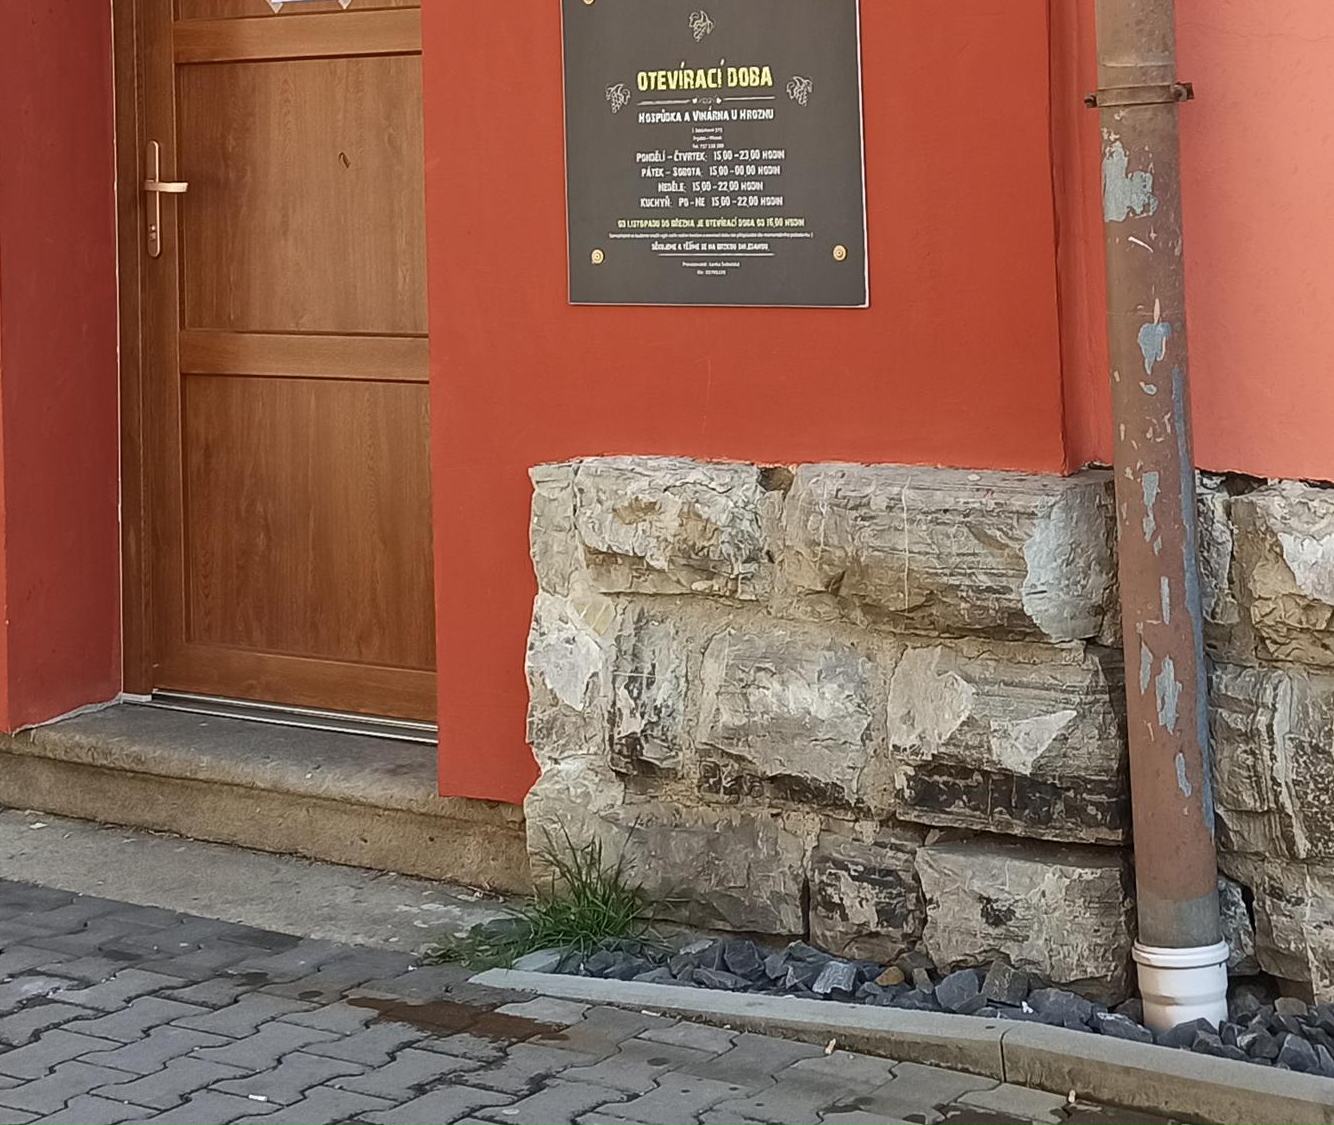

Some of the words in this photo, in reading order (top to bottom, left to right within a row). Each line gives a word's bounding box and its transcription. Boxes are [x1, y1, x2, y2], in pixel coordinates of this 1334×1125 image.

[637, 59, 725, 91] OTEVÍRACÍ
[727, 66, 773, 88] DOBA
[638, 109, 682, 123] HOSPŮDKA
[684, 111, 690, 122] A
[692, 105, 729, 121] VINÁRNA
[731, 109, 737, 120] U
[739, 108, 774, 120] HROZNU
